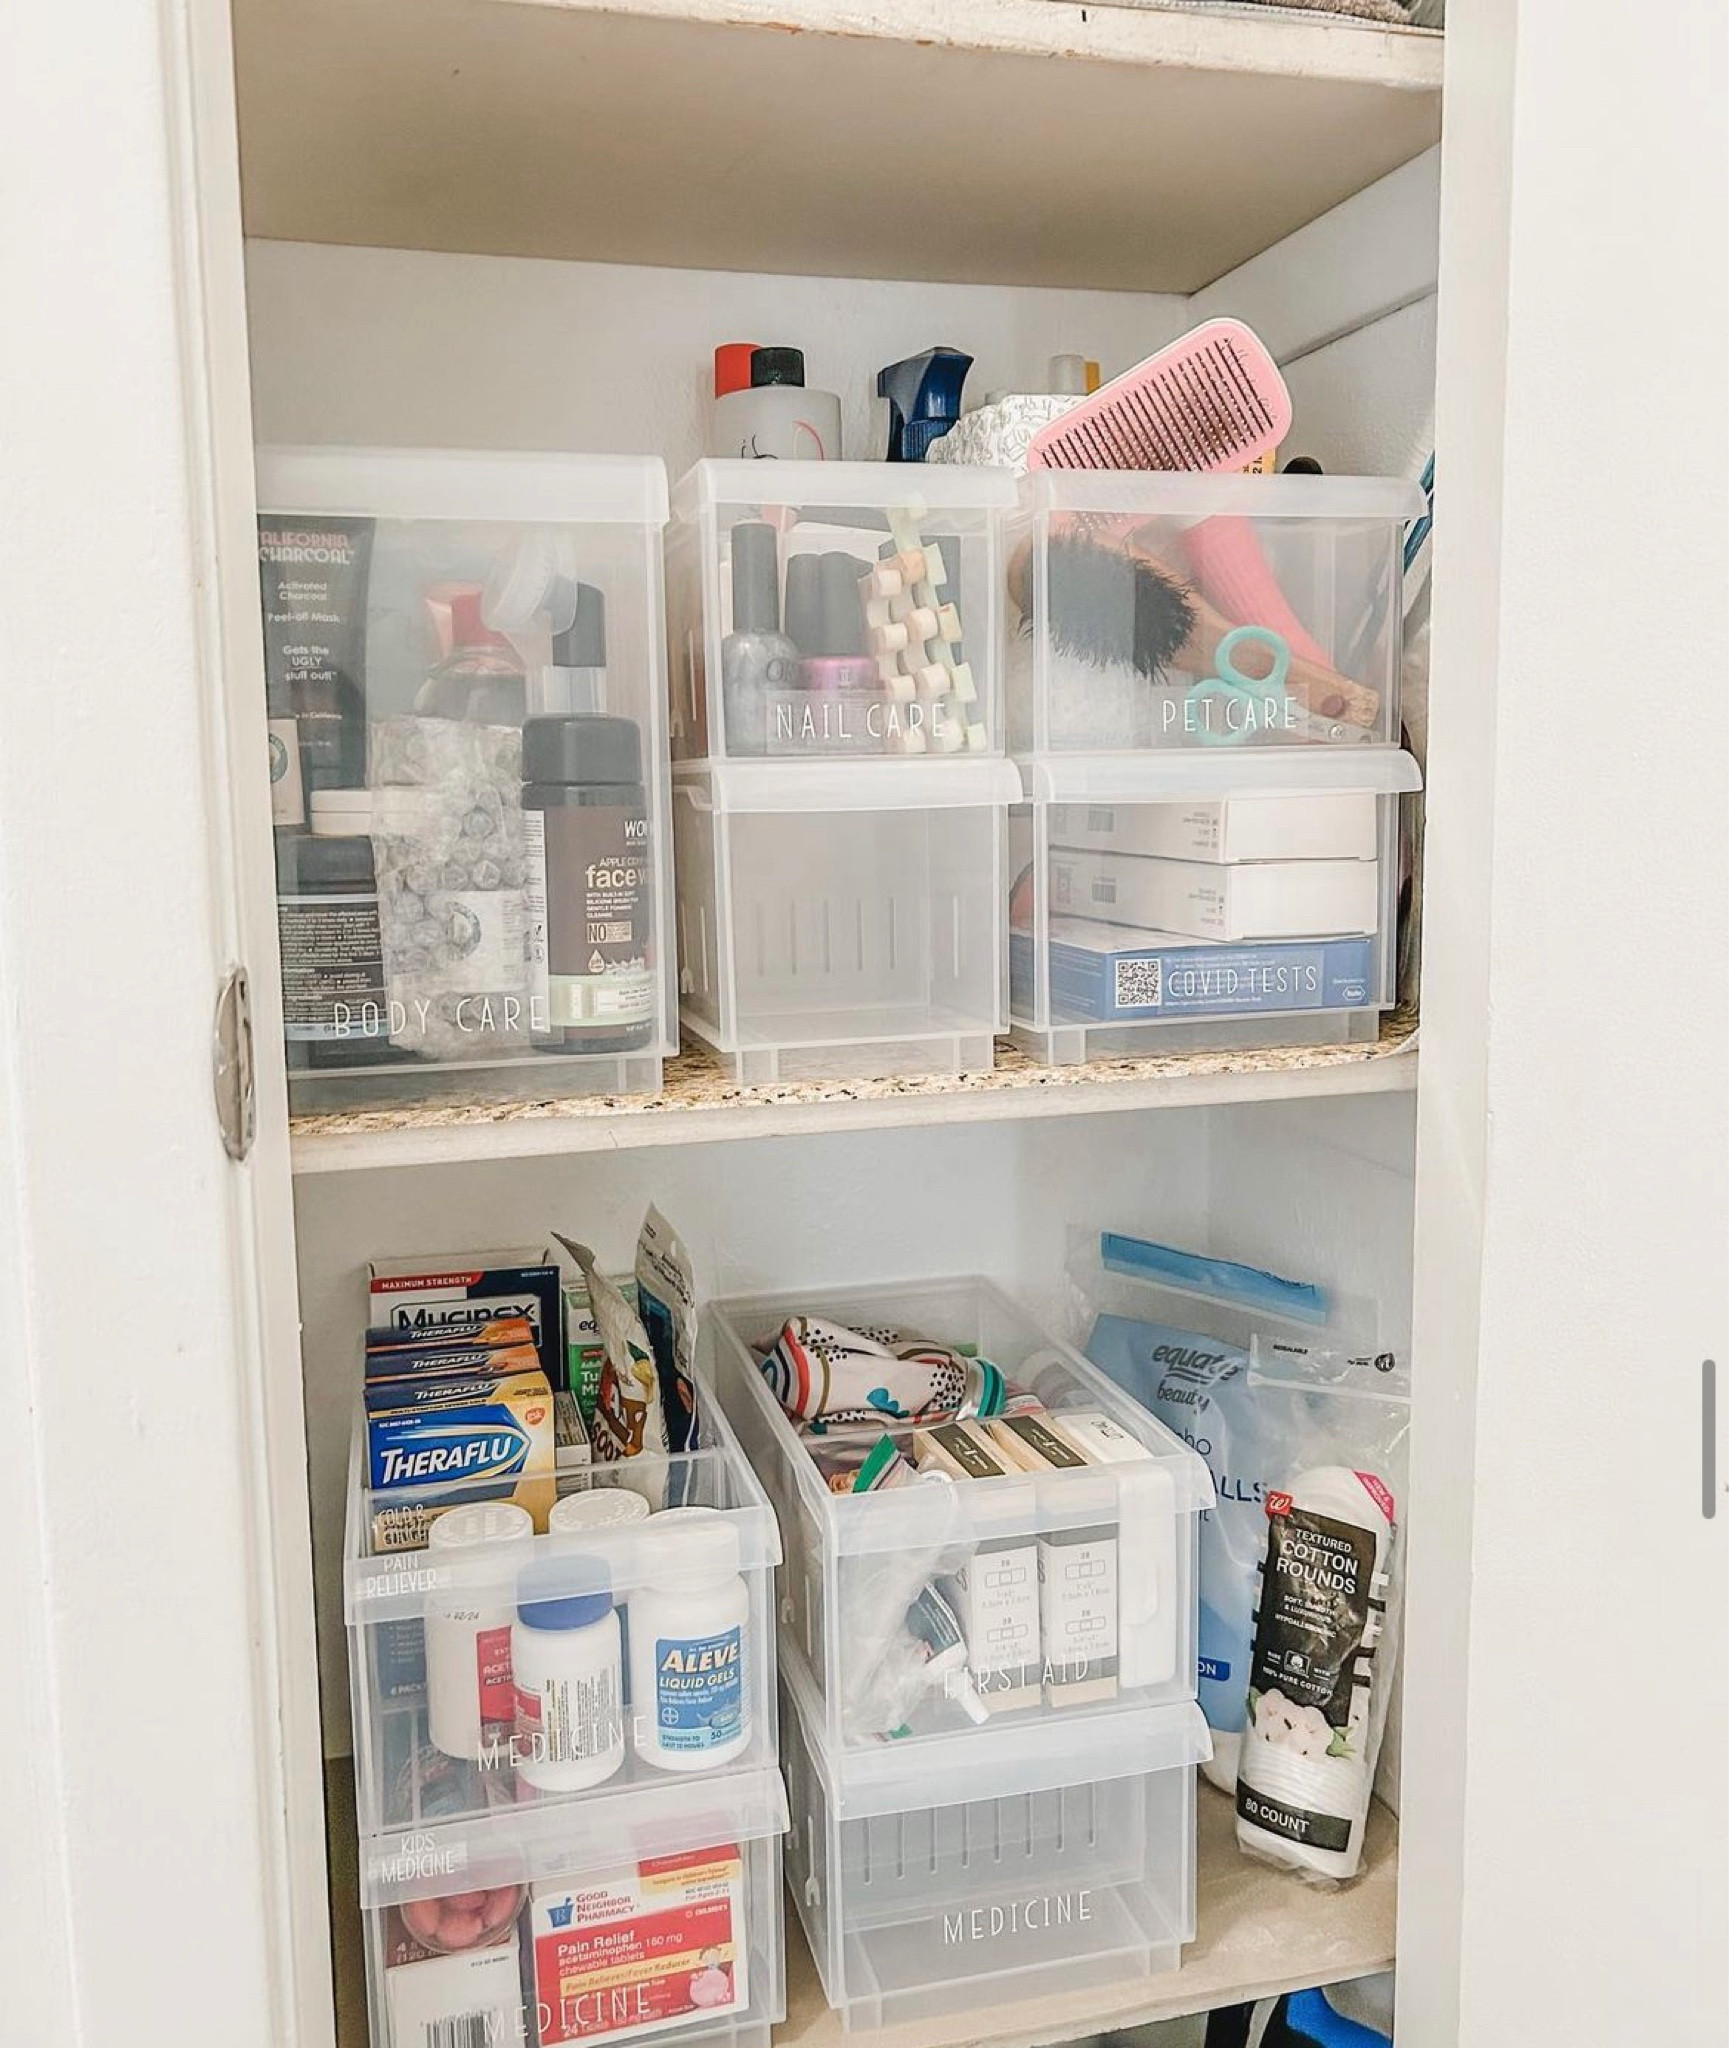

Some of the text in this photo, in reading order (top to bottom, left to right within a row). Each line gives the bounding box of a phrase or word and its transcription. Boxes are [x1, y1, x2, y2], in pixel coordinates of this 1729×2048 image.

[258, 531, 348, 548] ALIFORNIA
[283, 645, 329, 655] Gets the
[291, 656, 321, 667] UGLY
[776, 703, 946, 739] NAIL CARE
[1163, 697, 1297, 732] PET CARE
[585, 865, 636, 889] face
[589, 923, 607, 942] NO
[1168, 965, 1317, 997] COVID TESTS
[333, 1000, 431, 1038] BODY
[456, 995, 546, 1033] CARE
[382, 1276, 472, 1290] MAXIMUM STRENGTH
[410, 1323, 483, 1340] THERAFLU
[411, 1354, 489, 1370] THERAFLU
[1152, 1344, 1244, 1381] equate
[414, 1381, 495, 1401] THERAFLU
[1156, 1379, 1210, 1414] beauty
[380, 1435, 512, 1485] THERAFLU
[1295, 1527, 1353, 1555] TEXTURED
[383, 1553, 419, 1573] PAIN
[1281, 1539, 1360, 1577] COTTON
[366, 1568, 437, 1598] RELIEVER
[1275, 1557, 1357, 1595] ROUNDS
[661, 1641, 739, 1674] ALEVE
[660, 1667, 735, 1690] LIQUID GELS
[945, 1650, 1090, 1699] FIRST AID
[1279, 1672, 1298, 1686] PURE
[1300, 1680, 1334, 1698] COTTON
[478, 1715, 646, 1772] MEDICINE
[710, 1729, 722, 1740] 50
[1244, 1797, 1310, 1834] 80 COUNT
[401, 1833, 437, 1855] KIDS
[382, 1850, 456, 1885] MEDICINE
[576, 1890, 609, 1903] GOOD
[576, 1895, 632, 1913] NEIGHBOR
[576, 1904, 635, 1923] PHARMACY
[943, 1890, 1093, 1945] MEDICINE
[557, 1929, 636, 1957] Pain Relief
[558, 1933, 684, 1967] acetaminophen 160 mg
[558, 1949, 646, 1977] chewable tablets
[483, 1983, 650, 2045] MEDICINE
